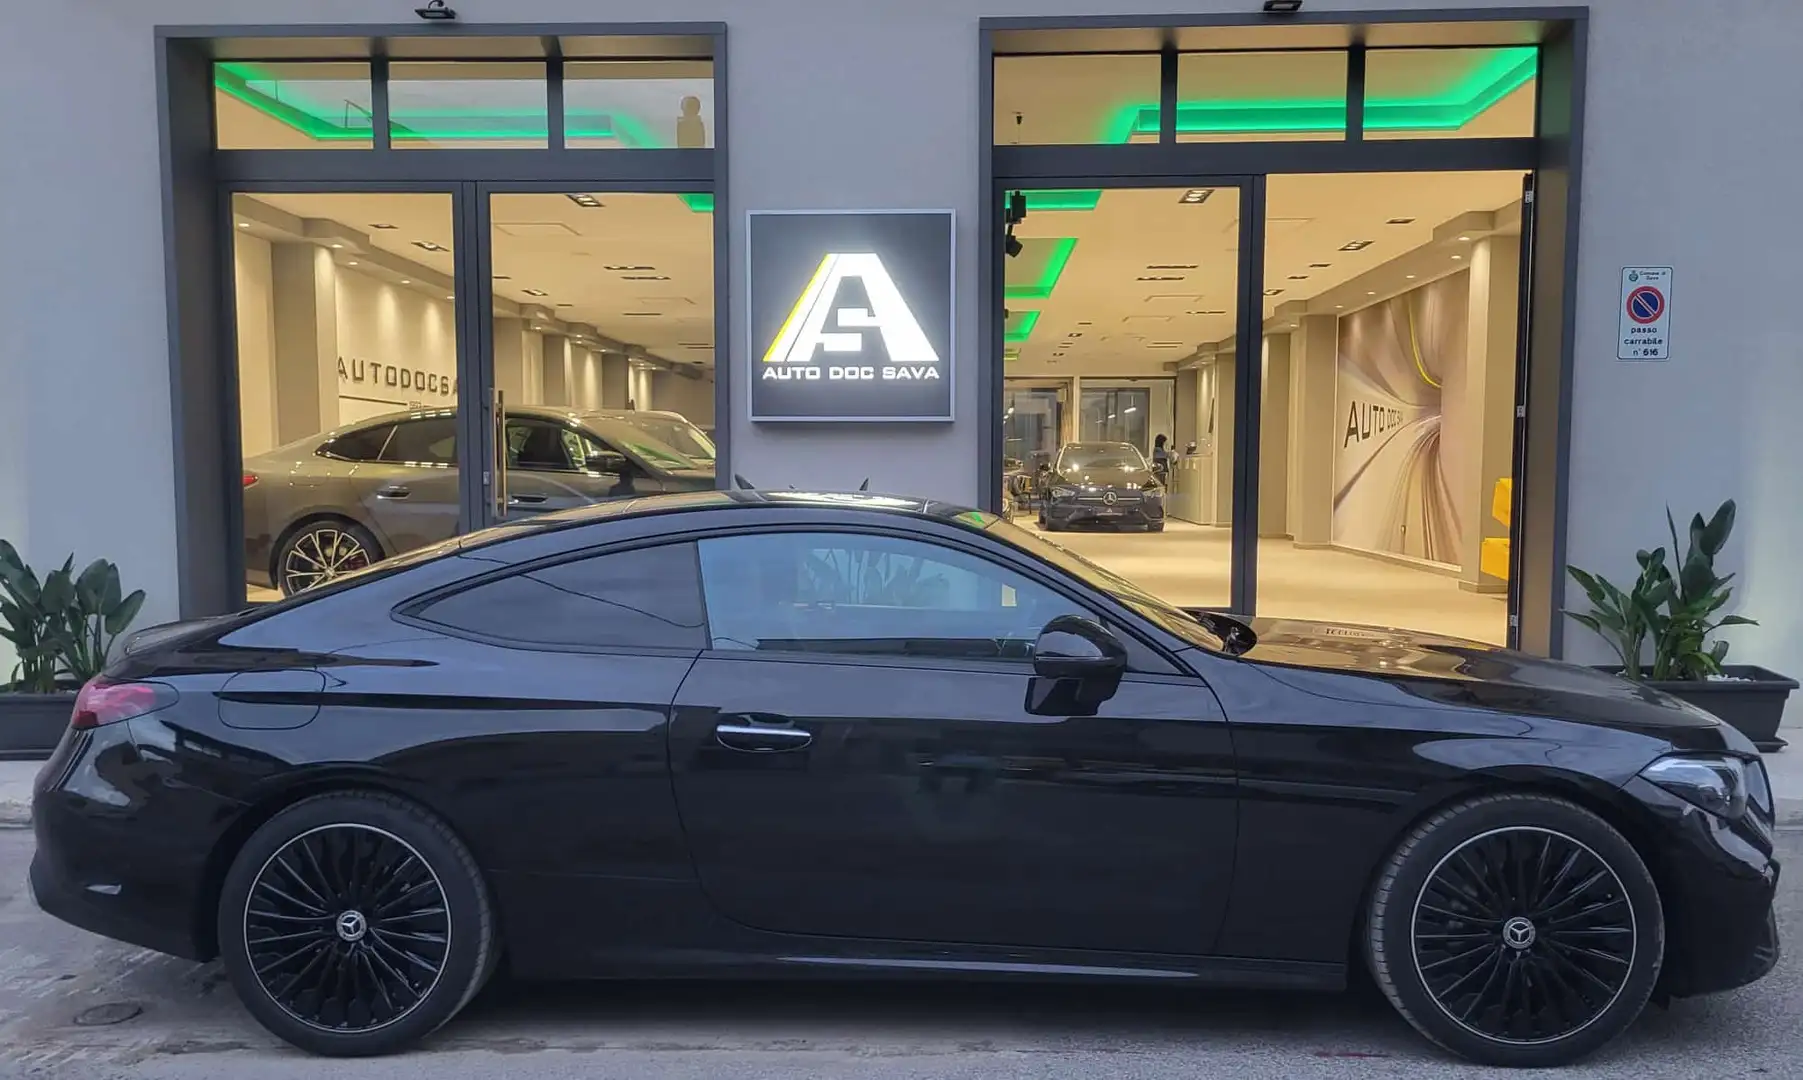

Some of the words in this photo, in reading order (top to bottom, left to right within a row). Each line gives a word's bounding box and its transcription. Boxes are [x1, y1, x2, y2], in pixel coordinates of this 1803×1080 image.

[1643, 348, 1659, 356] 616
[762, 366, 821, 380] AUTO
[829, 366, 875, 380] DOC
[882, 366, 940, 380] SAVA
[1343, 400, 1385, 448] AUTO
